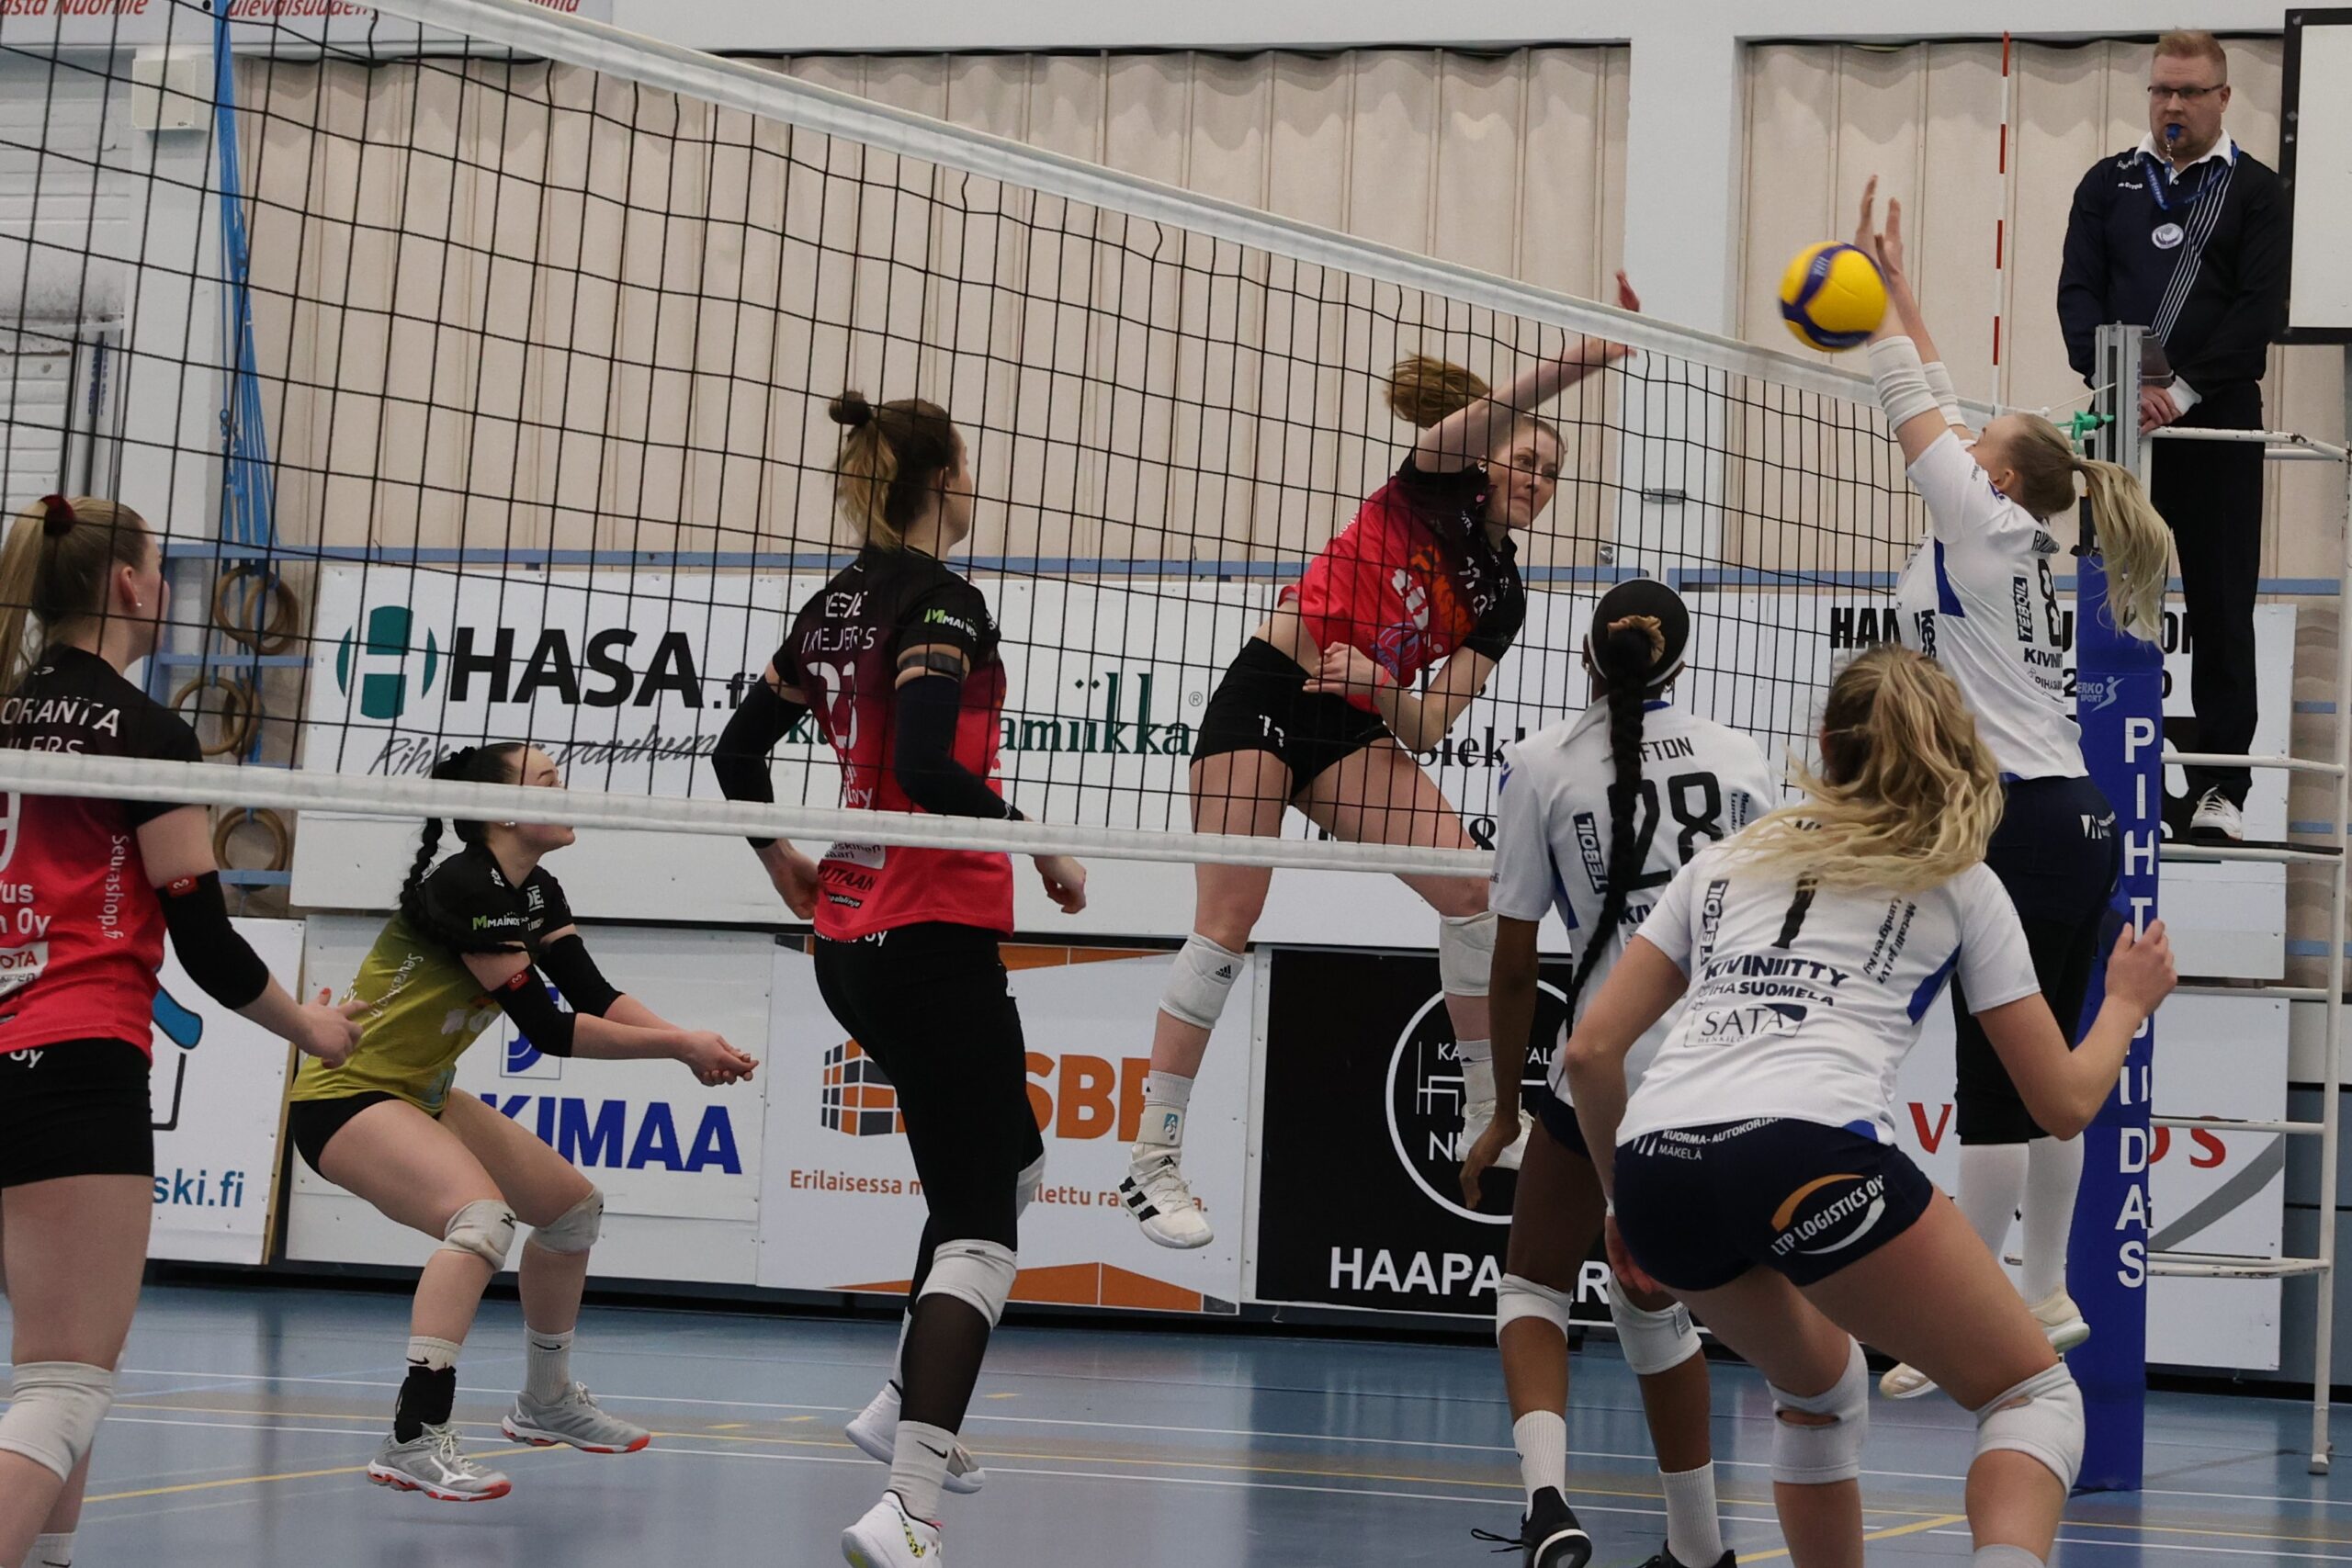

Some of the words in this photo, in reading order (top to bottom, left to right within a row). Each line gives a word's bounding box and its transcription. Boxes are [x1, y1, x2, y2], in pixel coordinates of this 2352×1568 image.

[1704, 954, 1849, 987] KIVINIITTY
[1701, 1008, 1783, 1037] SATA
[153, 1168, 245, 1209] ski.fi
[790, 1169, 902, 1196] Erilaisessa
[1770, 1232, 1795, 1257] LTP
[1793, 1186, 1869, 1242] LOGISTICS
